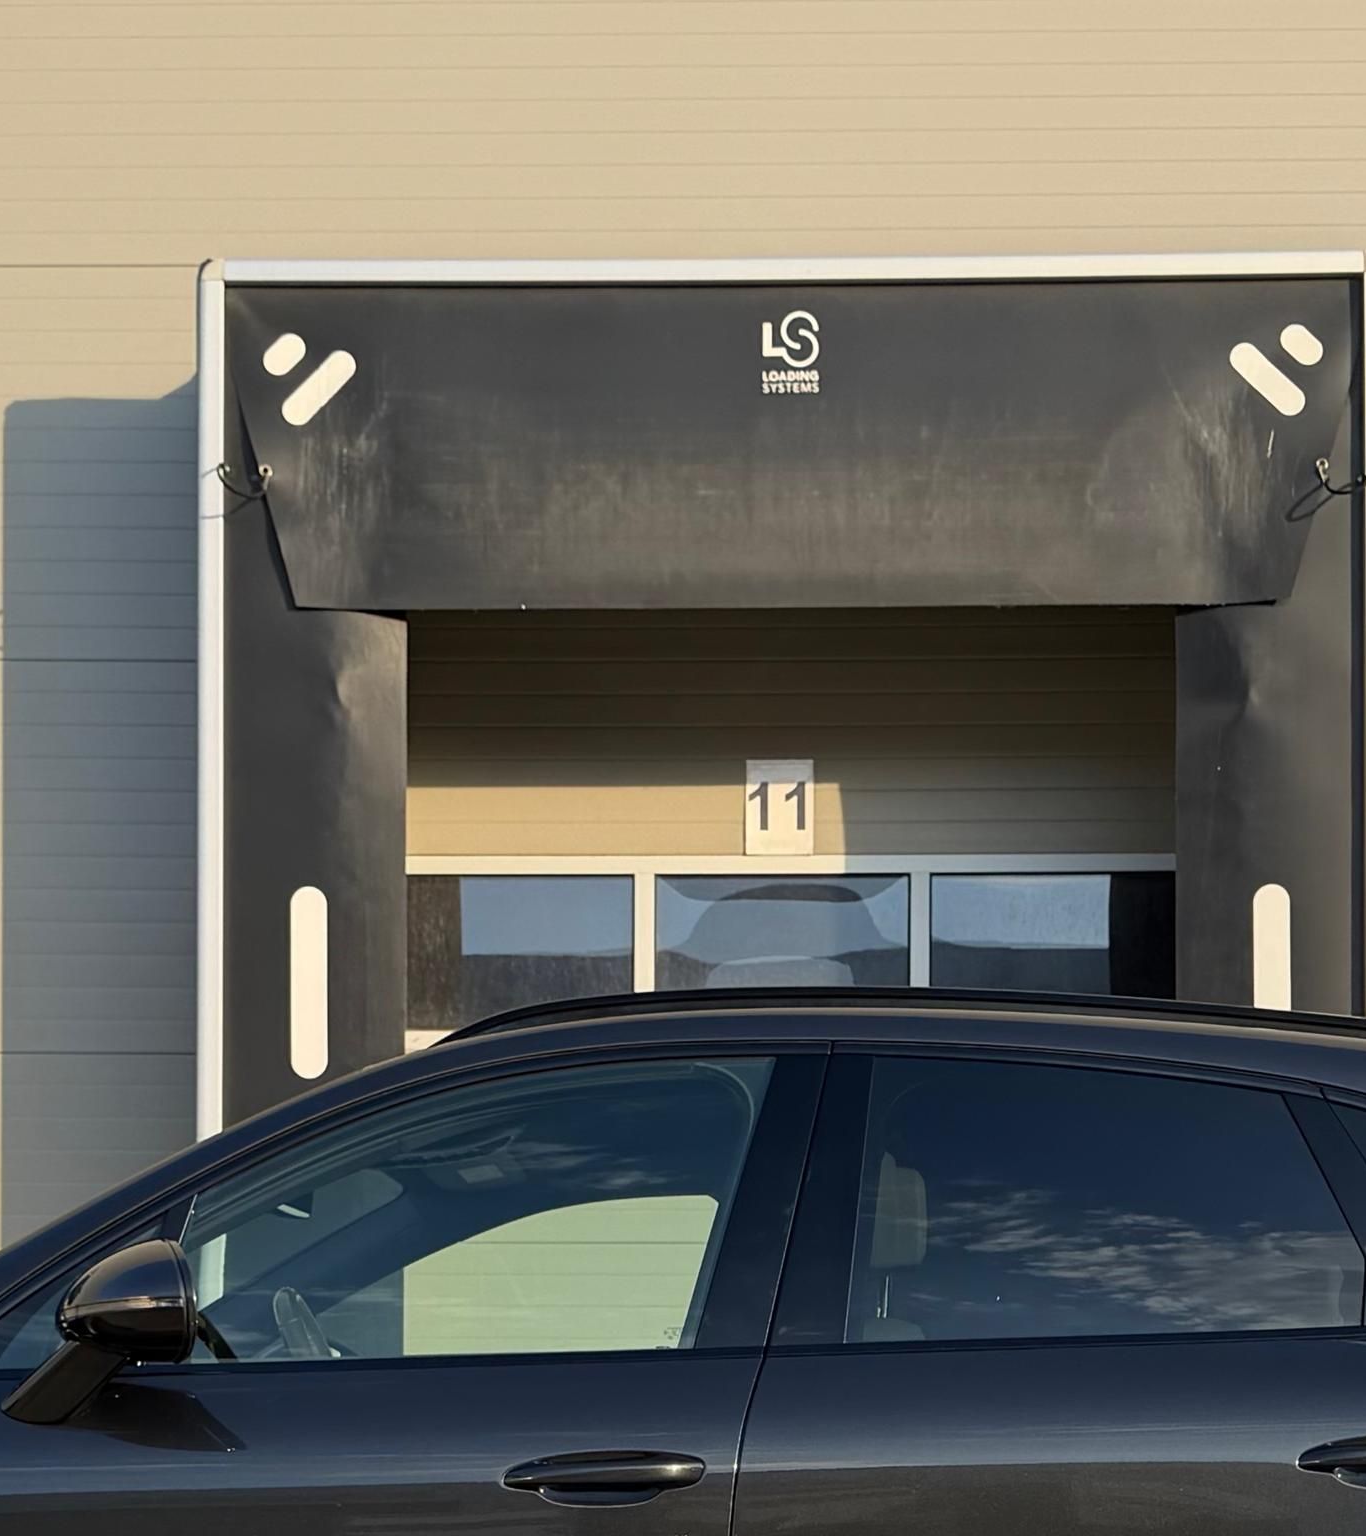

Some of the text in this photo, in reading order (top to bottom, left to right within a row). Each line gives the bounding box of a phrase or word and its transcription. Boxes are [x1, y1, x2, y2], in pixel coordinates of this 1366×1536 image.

[762, 310, 819, 368] LS
[762, 370, 819, 382] LOADING
[762, 382, 819, 394] SYSTEMS
[748, 781, 806, 831] 11
